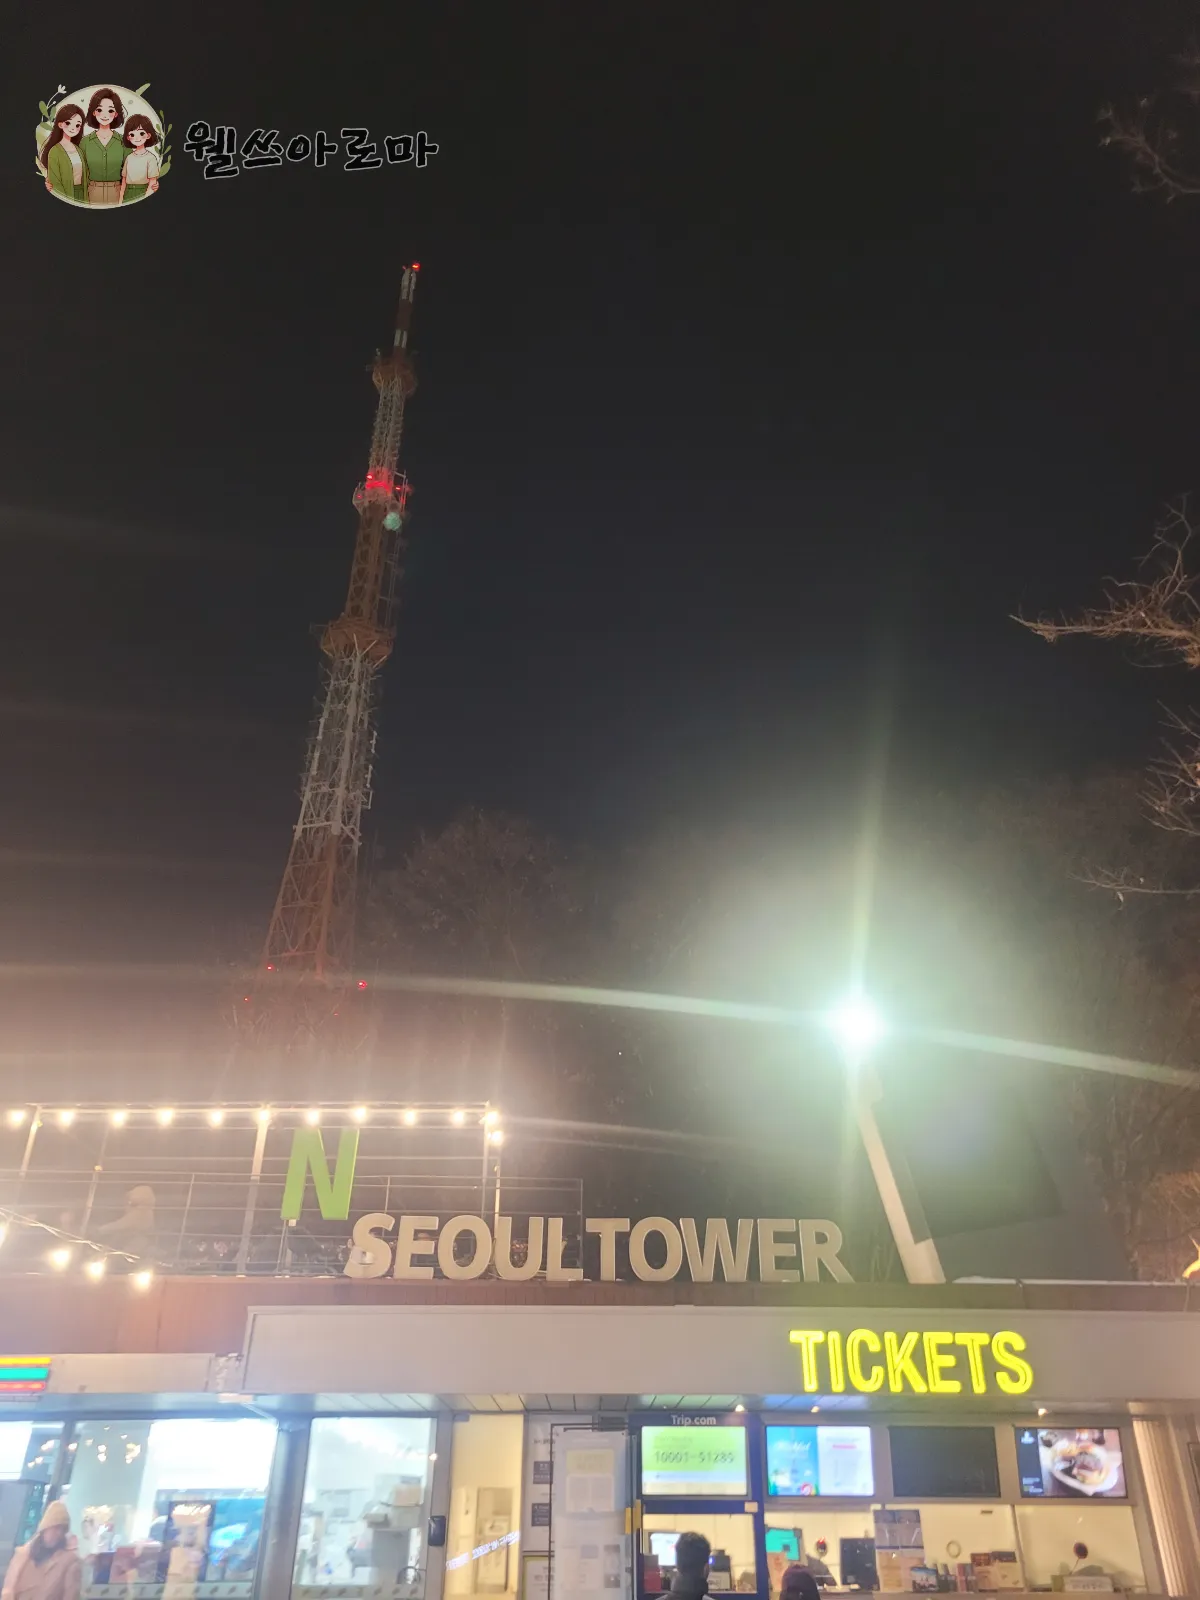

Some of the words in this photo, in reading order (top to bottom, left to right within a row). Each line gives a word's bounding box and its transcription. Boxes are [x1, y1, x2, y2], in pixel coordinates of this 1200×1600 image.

[281, 1128, 361, 1220] N
[343, 1212, 584, 1283] SEOUL
[585, 1217, 855, 1283] TOWER
[789, 1328, 1034, 1395] TICKETS
[670, 1413, 717, 1427] Trip.com
